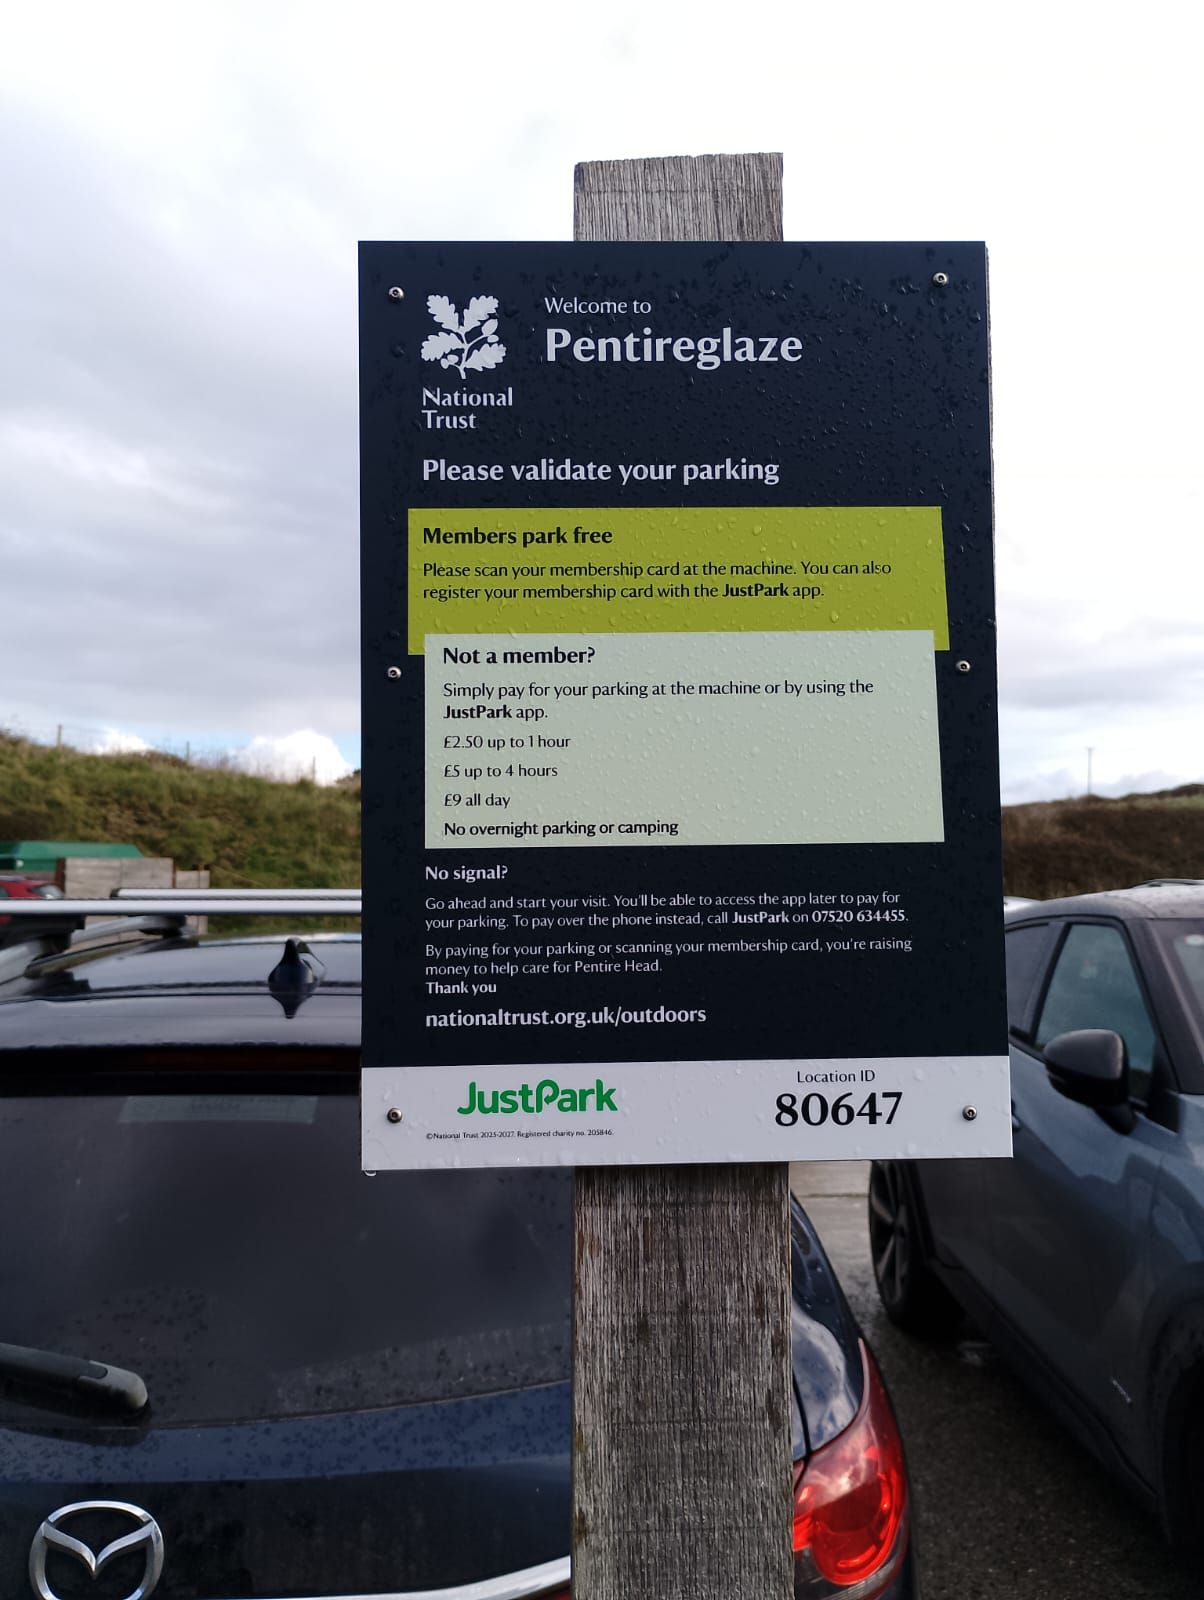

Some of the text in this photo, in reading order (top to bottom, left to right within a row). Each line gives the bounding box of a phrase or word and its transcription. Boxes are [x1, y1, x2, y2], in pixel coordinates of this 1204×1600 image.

[544, 297, 651, 313] Welcome to
[547, 327, 802, 370] Pentireglaze
[423, 387, 512, 406] National
[422, 410, 476, 429] Trust
[423, 458, 779, 485] Please validate your parking
[423, 526, 612, 548] Members park free
[424, 560, 891, 580] Please scan your membership card at the machine. You can also
[424, 583, 824, 602] register your membership card with the JustPark app.
[443, 646, 595, 664] Not a member?
[443, 679, 873, 700] Simply pay for your parking at the machine or by using the
[443, 704, 548, 721] JustPark app.
[444, 735, 571, 751] £2.50 up to 1 hour
[444, 764, 558, 780] £5 up to 4 hours
[444, 793, 510, 808] £9 all day
[445, 820, 679, 838] No overnight parking or camping
[426, 865, 508, 883] No signal?
[425, 891, 900, 910] Go ahead and start your visit. You'll be able to access the app later to pay for
[425, 909, 908, 931] your parking. To pay over the phone instead, call JustPark on 07520 634455.
[426, 937, 912, 959] By paying for your parking or scanning your membership card, you're raising
[426, 959, 662, 977] money to help care for Pentire Head.
[426, 981, 496, 996] Thank you
[426, 1006, 706, 1028] nationaltrust.org.uk/outdoors
[797, 1070, 875, 1083] Location ID
[457, 1079, 618, 1115] JustPark
[775, 1092, 903, 1127] 80647
[516, 1130, 551, 1139] Registered
[552, 1129, 575, 1139] charity
